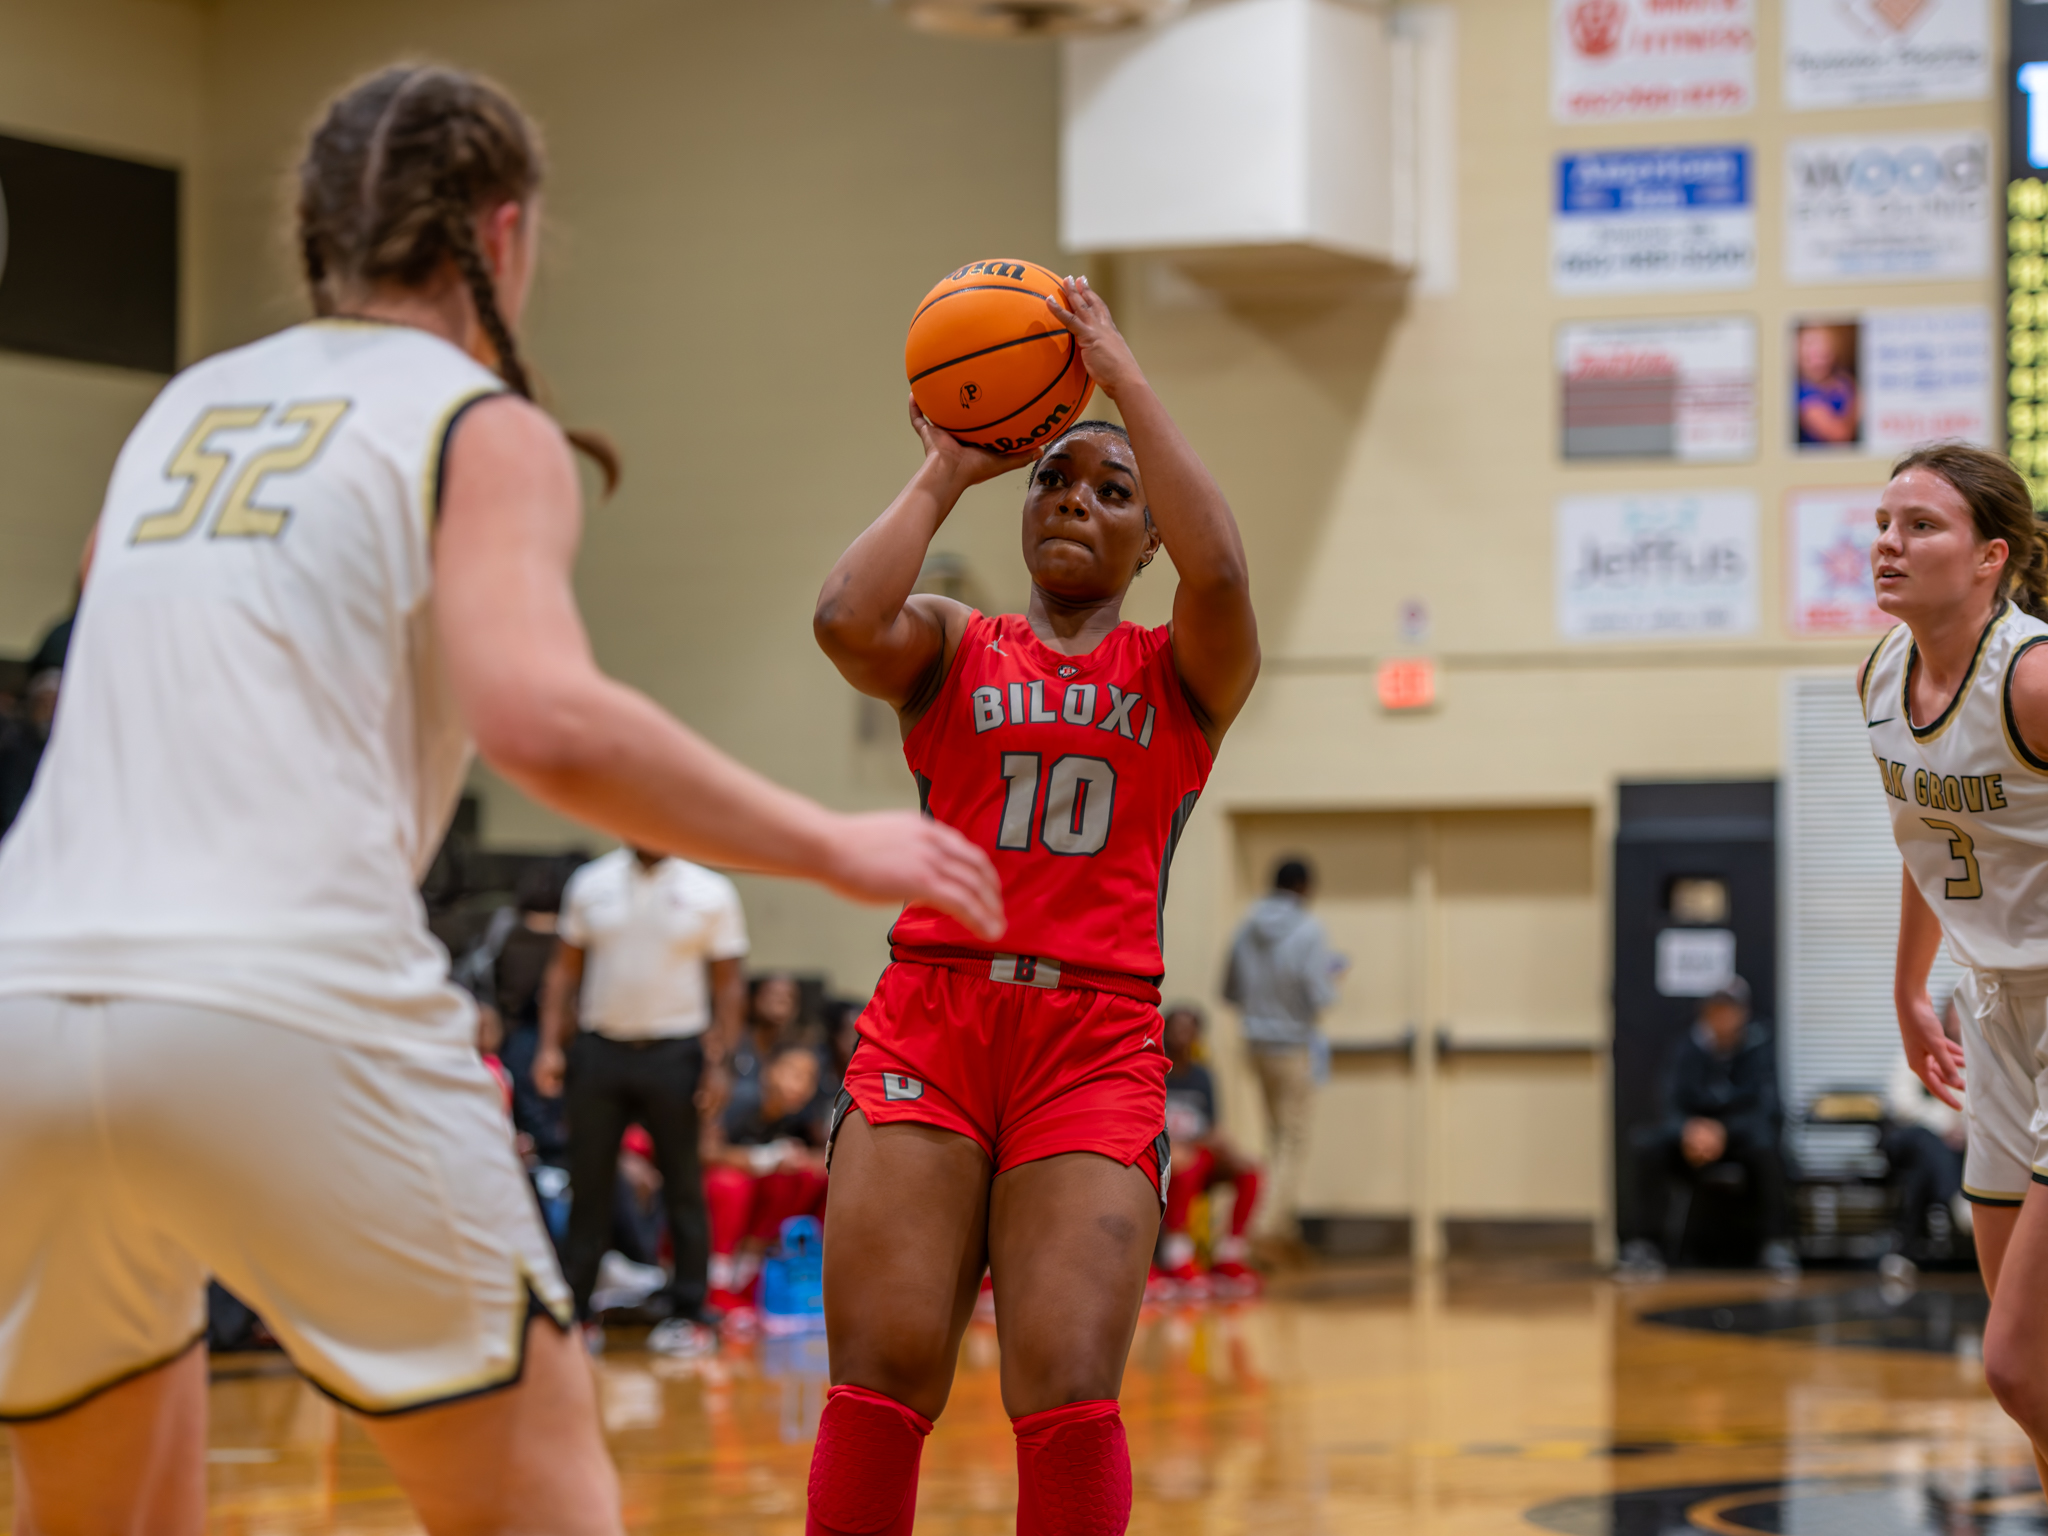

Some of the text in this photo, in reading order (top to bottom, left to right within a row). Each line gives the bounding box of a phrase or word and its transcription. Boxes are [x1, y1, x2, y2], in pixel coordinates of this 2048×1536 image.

[964, 384, 977, 400] P
[127, 398, 354, 546] 52
[971, 680, 1156, 750] BILOXI
[996, 751, 1118, 858] 10
[1873, 753, 2008, 813] AK GROVE
[1919, 817, 1983, 900] 3
[1013, 955, 1038, 982] B
